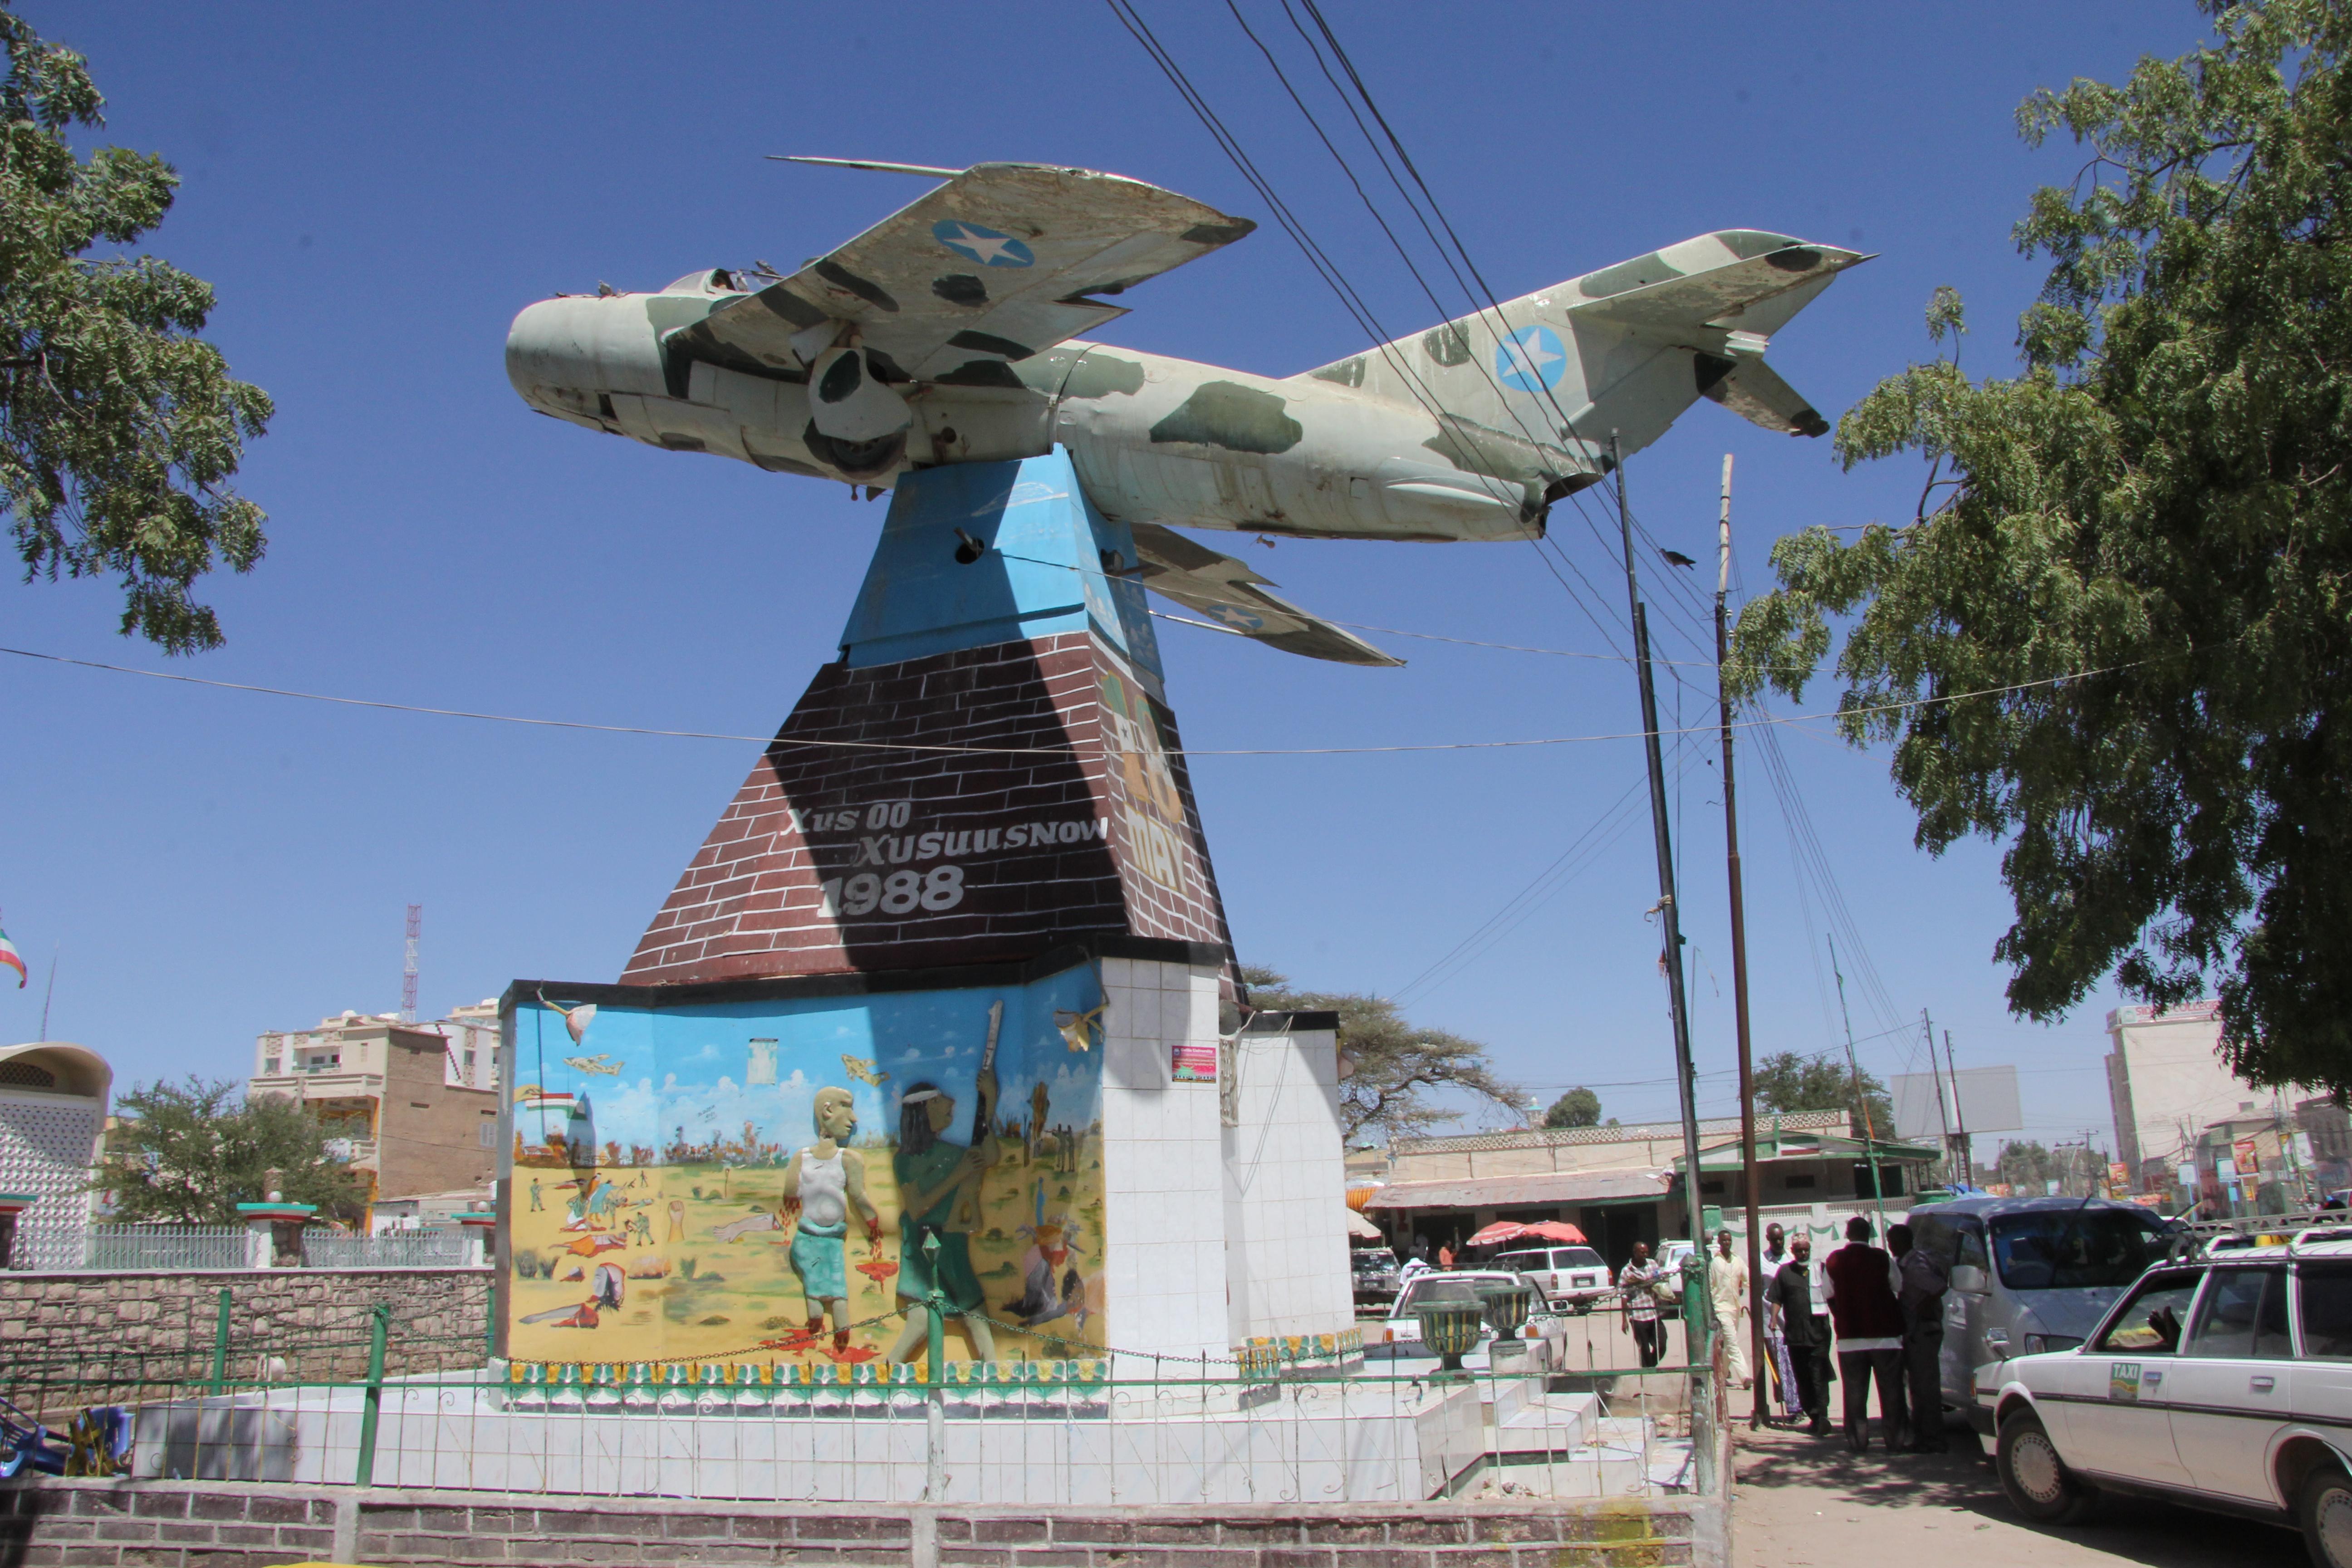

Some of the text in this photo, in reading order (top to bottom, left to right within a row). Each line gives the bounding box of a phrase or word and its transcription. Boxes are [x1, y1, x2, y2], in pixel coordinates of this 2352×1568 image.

[1101, 670, 1182, 823] 18
[1124, 801, 1189, 897] MAY
[817, 865, 964, 917] 1988
[2114, 1364, 2138, 1379] TAXI
